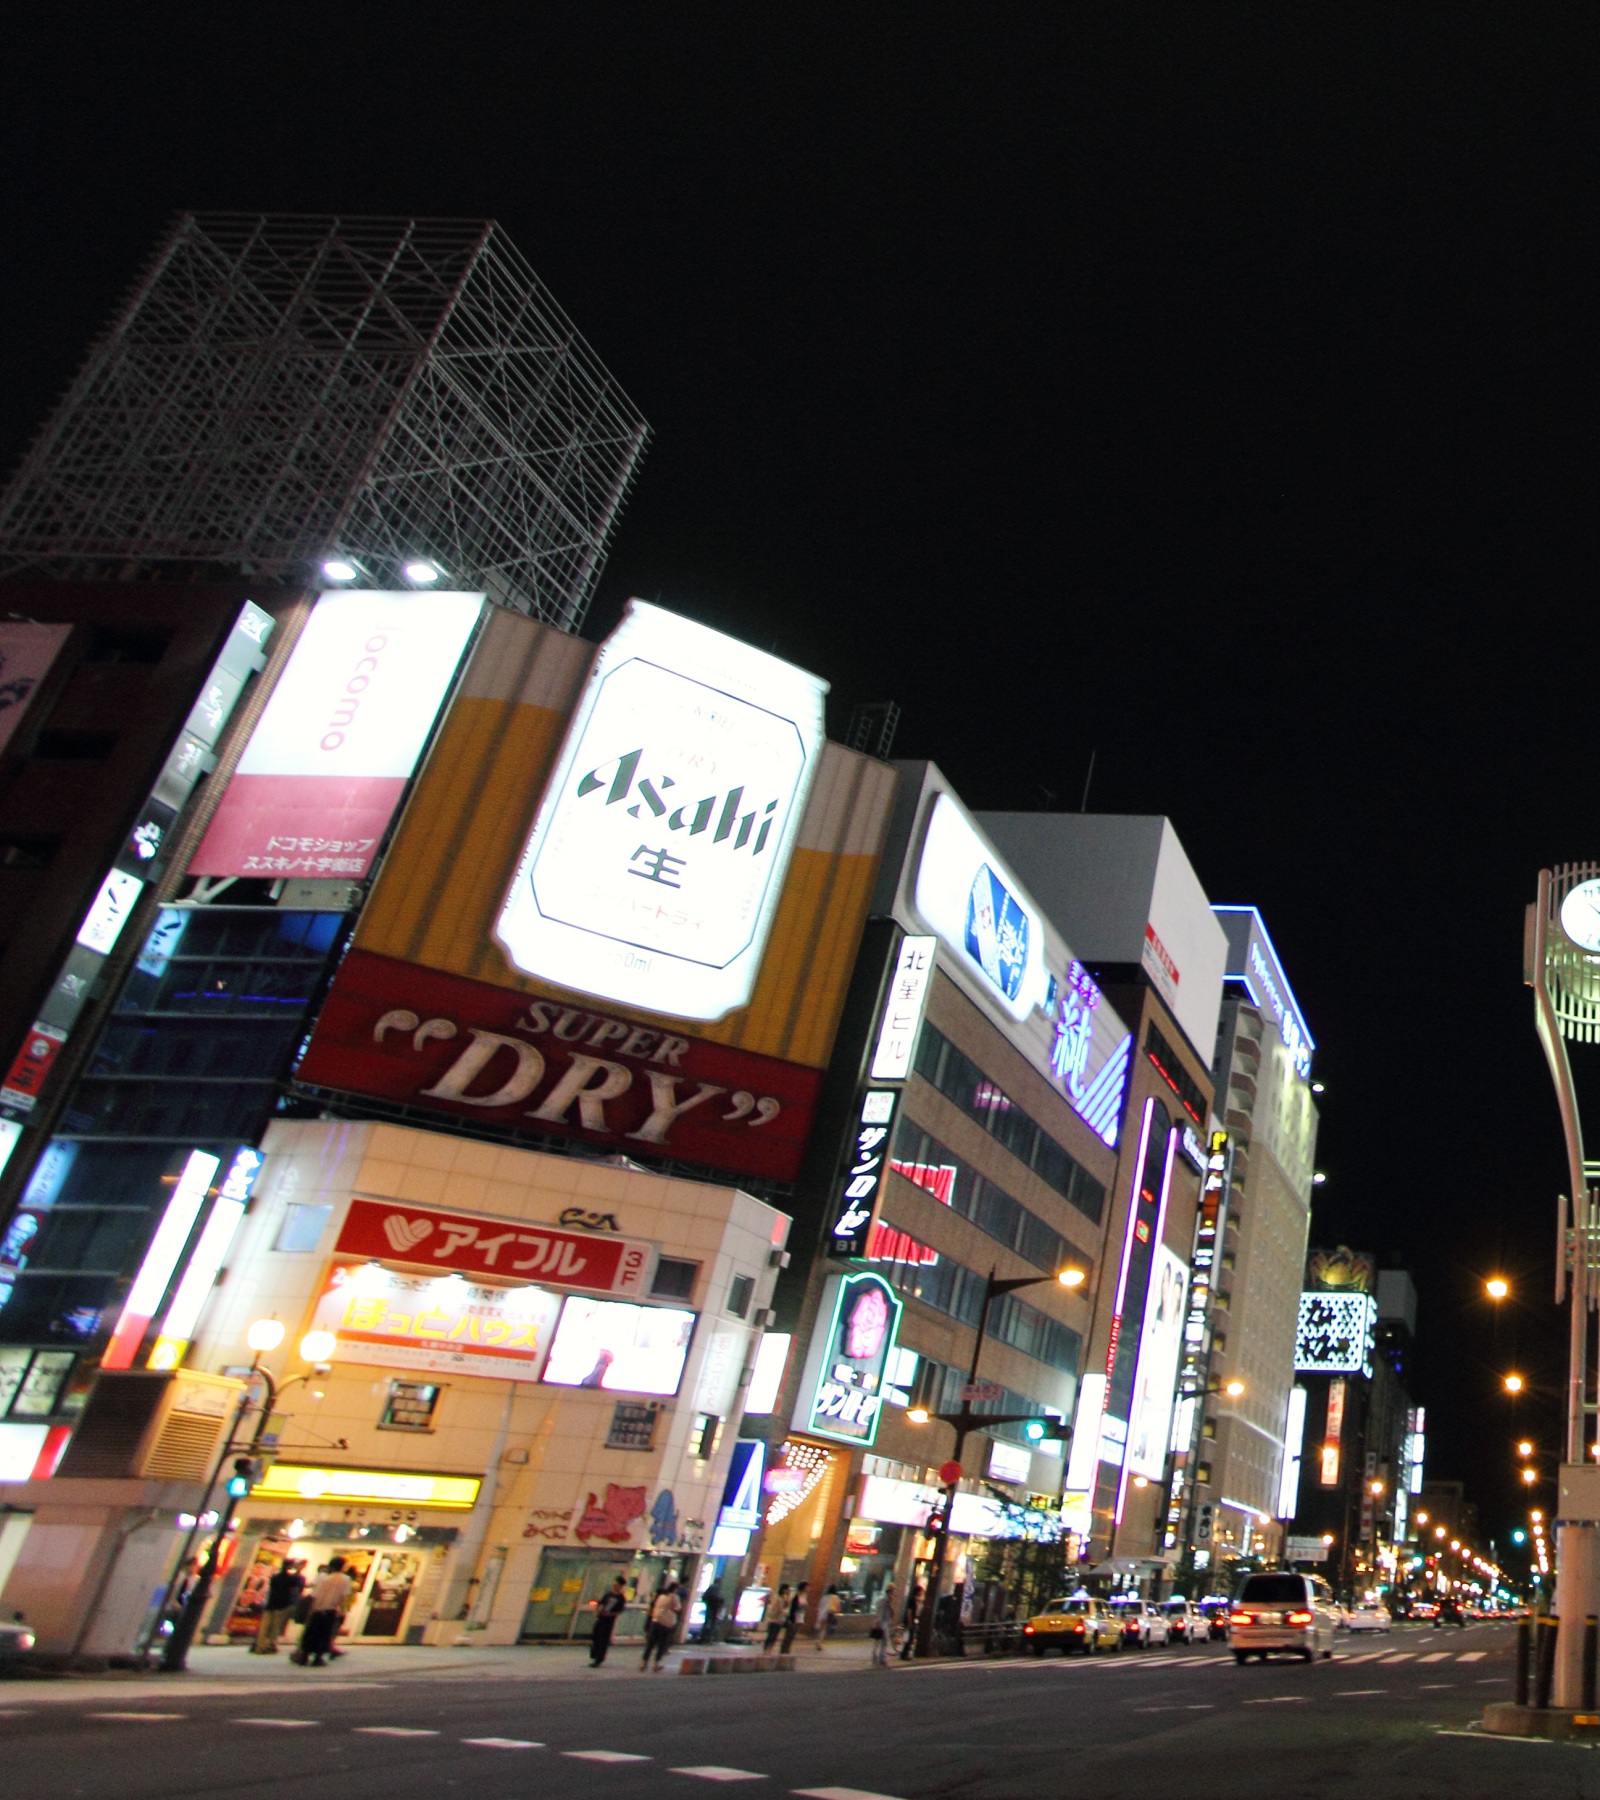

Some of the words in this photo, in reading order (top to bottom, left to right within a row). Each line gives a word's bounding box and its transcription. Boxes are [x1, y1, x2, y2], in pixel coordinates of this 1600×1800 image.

[577, 748, 779, 856] Asahi
[266, 836, 376, 853] ドコモショップ
[627, 844, 687, 889] 生
[514, 1001, 690, 1067] SUPER
[834, 1127, 888, 1237] サンローゼ
[432, 1221, 588, 1277] アイフル
[620, 1250, 644, 1287] 3F
[338, 1294, 540, 1350] ほっとハウス
[817, 1381, 881, 1427] サンローゼ
